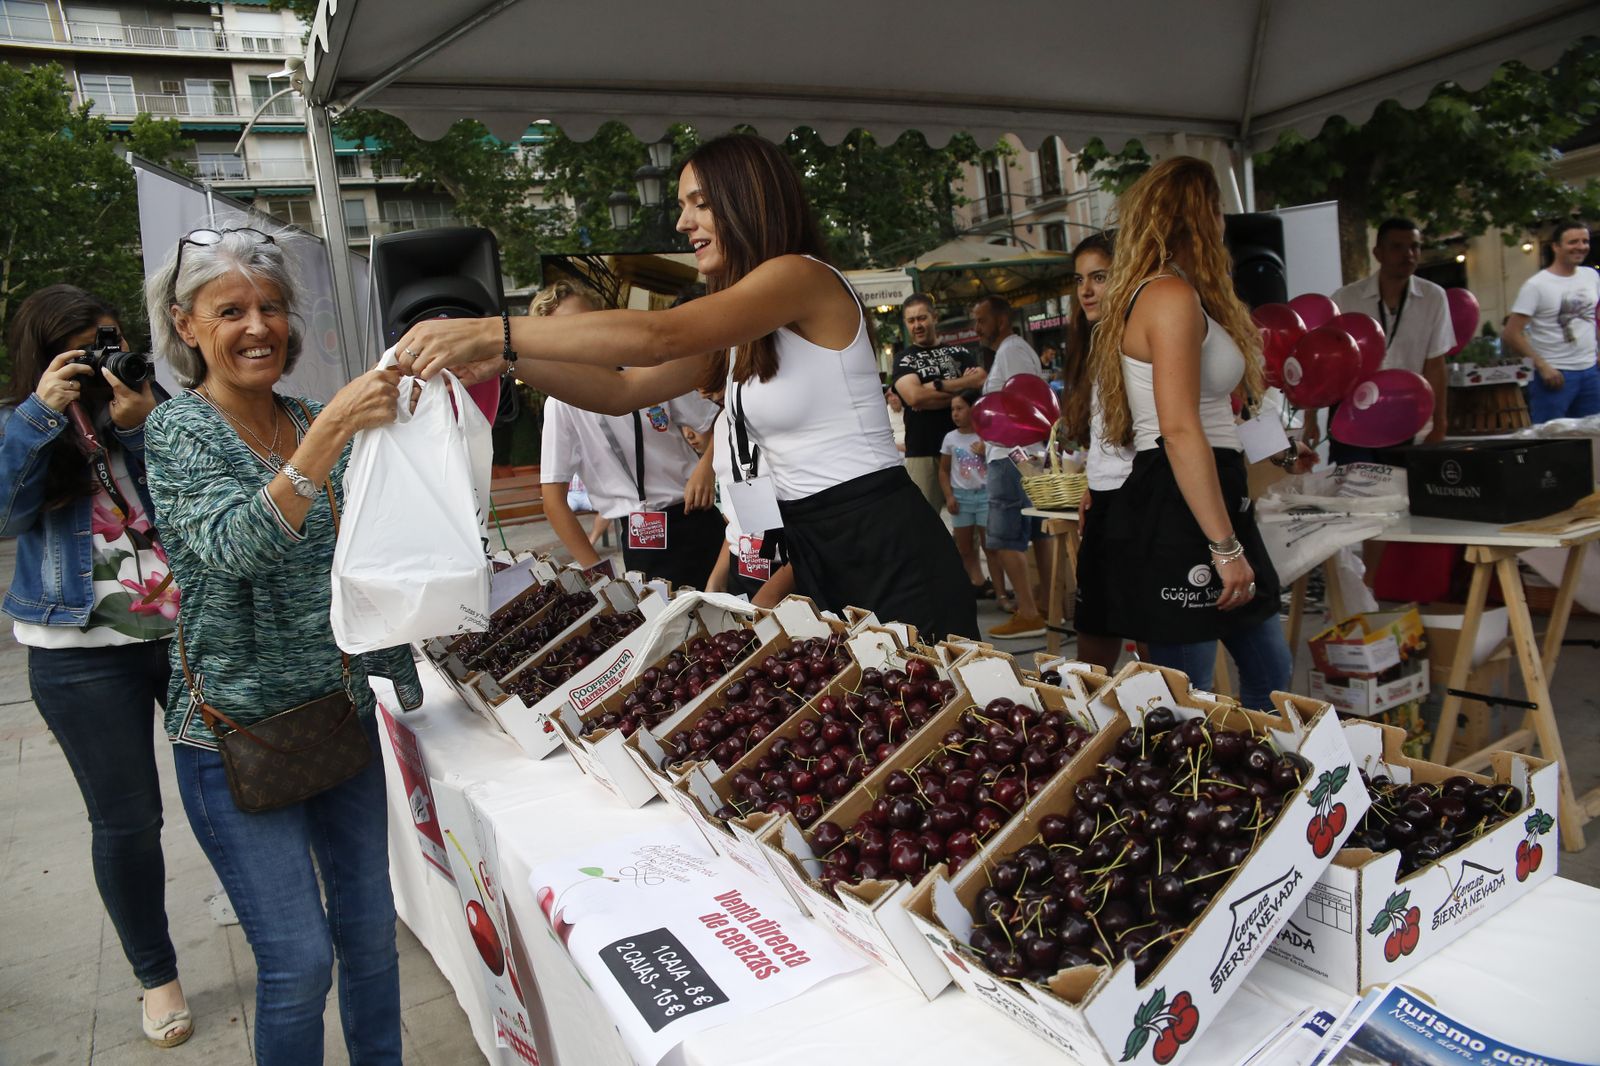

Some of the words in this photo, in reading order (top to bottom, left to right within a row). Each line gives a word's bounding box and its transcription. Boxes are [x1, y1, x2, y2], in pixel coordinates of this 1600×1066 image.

[97, 462, 117, 495] SONY
[1160, 587, 1202, 608] Güéjar
[572, 652, 631, 700] COOPERATIVA
[580, 681, 608, 708] MAITENA
[607, 676, 620, 688] DEL
[1255, 870, 1303, 934] NEVADA
[1457, 874, 1484, 899] Cerezas
[1469, 873, 1506, 907] NEVADA
[713, 889, 761, 924] Venta
[746, 918, 811, 968] directa
[1235, 893, 1270, 942] Cerezas
[616, 942, 636, 953] 2
[652, 945, 671, 955] 1
[698, 912, 729, 929] de
[714, 927, 780, 981] cerezas
[1276, 929, 1315, 954] ADA
[622, 950, 660, 985] CAJAS
[657, 951, 691, 982] CAJA
[1388, 1008, 1435, 1040] Nuestra
[1396, 996, 1487, 1053] turismo
